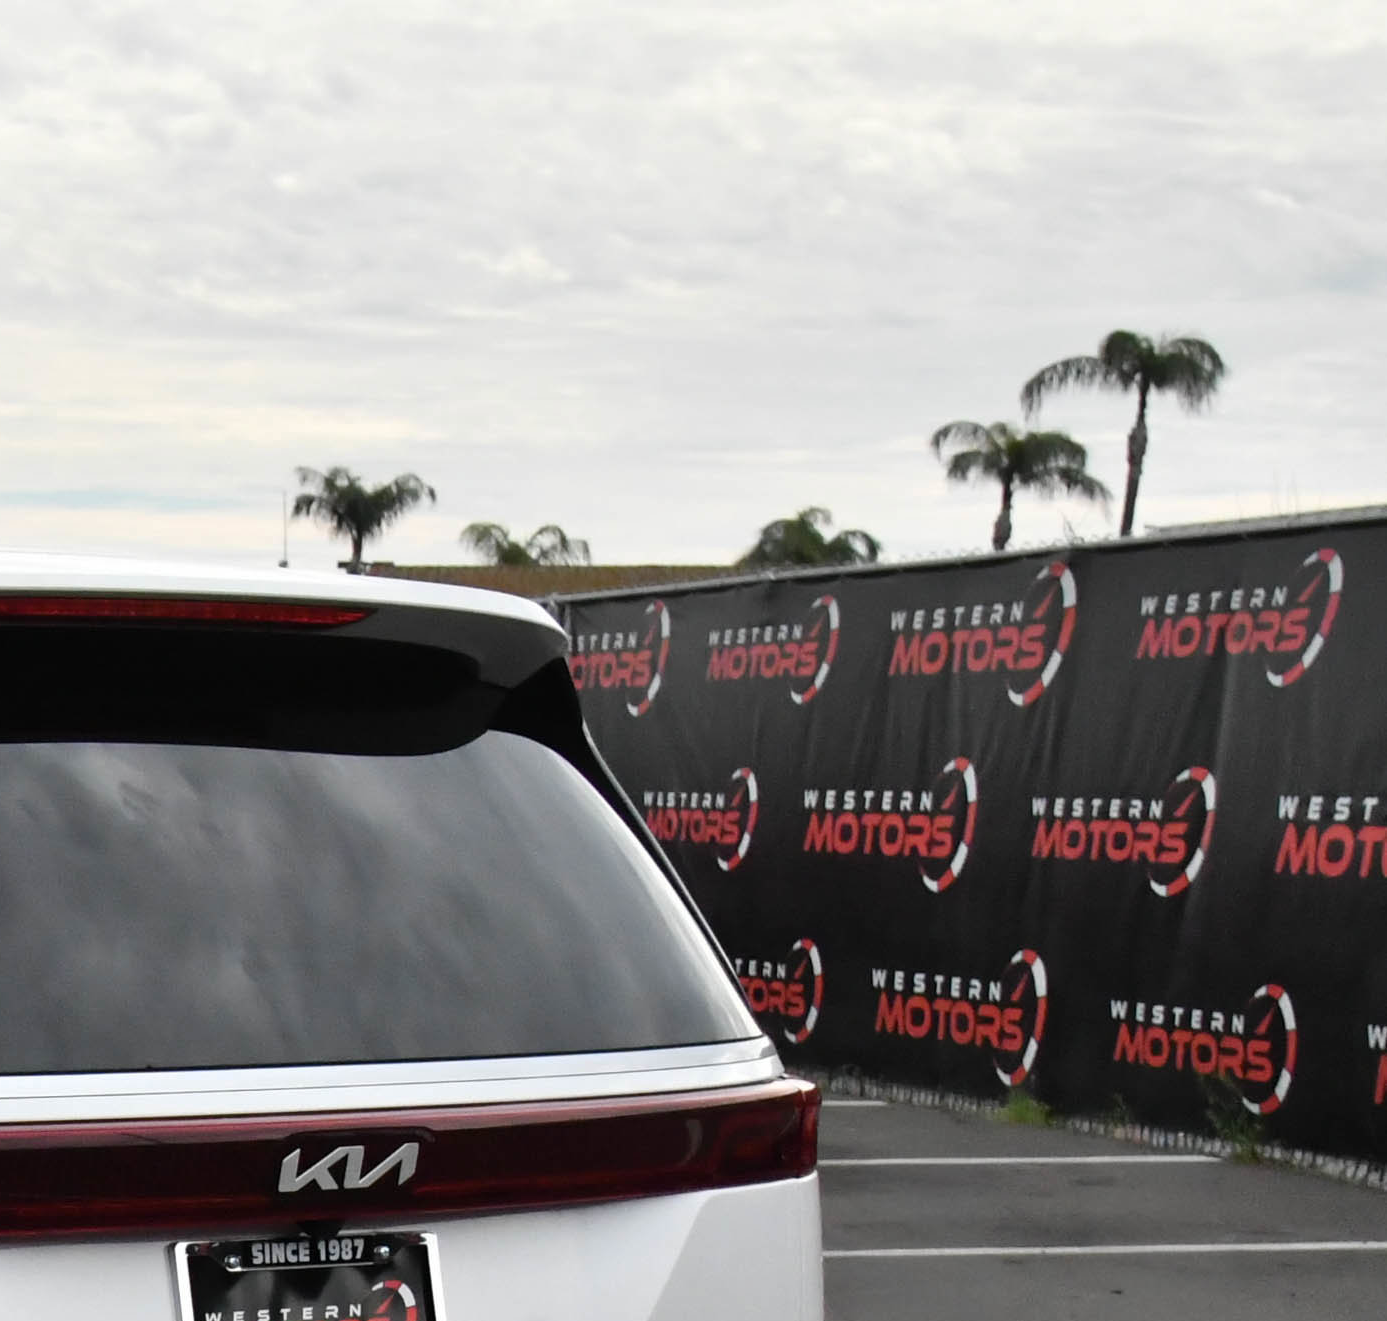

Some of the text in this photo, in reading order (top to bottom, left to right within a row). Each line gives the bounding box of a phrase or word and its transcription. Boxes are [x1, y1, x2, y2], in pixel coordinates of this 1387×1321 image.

[891, 601, 1024, 631] WESTERN
[1140, 586, 1288, 616] WESTERN
[569, 632, 637, 652] STERN
[709, 624, 803, 646] WESTERN
[888, 624, 1046, 676] MOTORS
[1135, 607, 1311, 659] MOTORS
[569, 650, 652, 690] OTORS
[707, 642, 818, 681] MOTORS
[644, 791, 725, 809] WESTERN
[804, 789, 933, 812] WESTERN
[1032, 797, 1163, 820] WESTERN
[646, 808, 741, 844] MOTORS
[803, 812, 955, 858] MOTORS
[1031, 819, 1189, 864] MOTORS
[1274, 822, 1387, 879] MOT
[735, 957, 786, 979] TERN
[872, 968, 1001, 1002] WESTERN
[739, 976, 806, 1017] ORS
[875, 992, 1024, 1051] MOTORS
[1110, 1000, 1245, 1035] WESTERN
[1114, 1022, 1273, 1083] MOTORS
[278, 1142, 419, 1192] KIA
[251, 1238, 365, 1265] SINCE 1987
